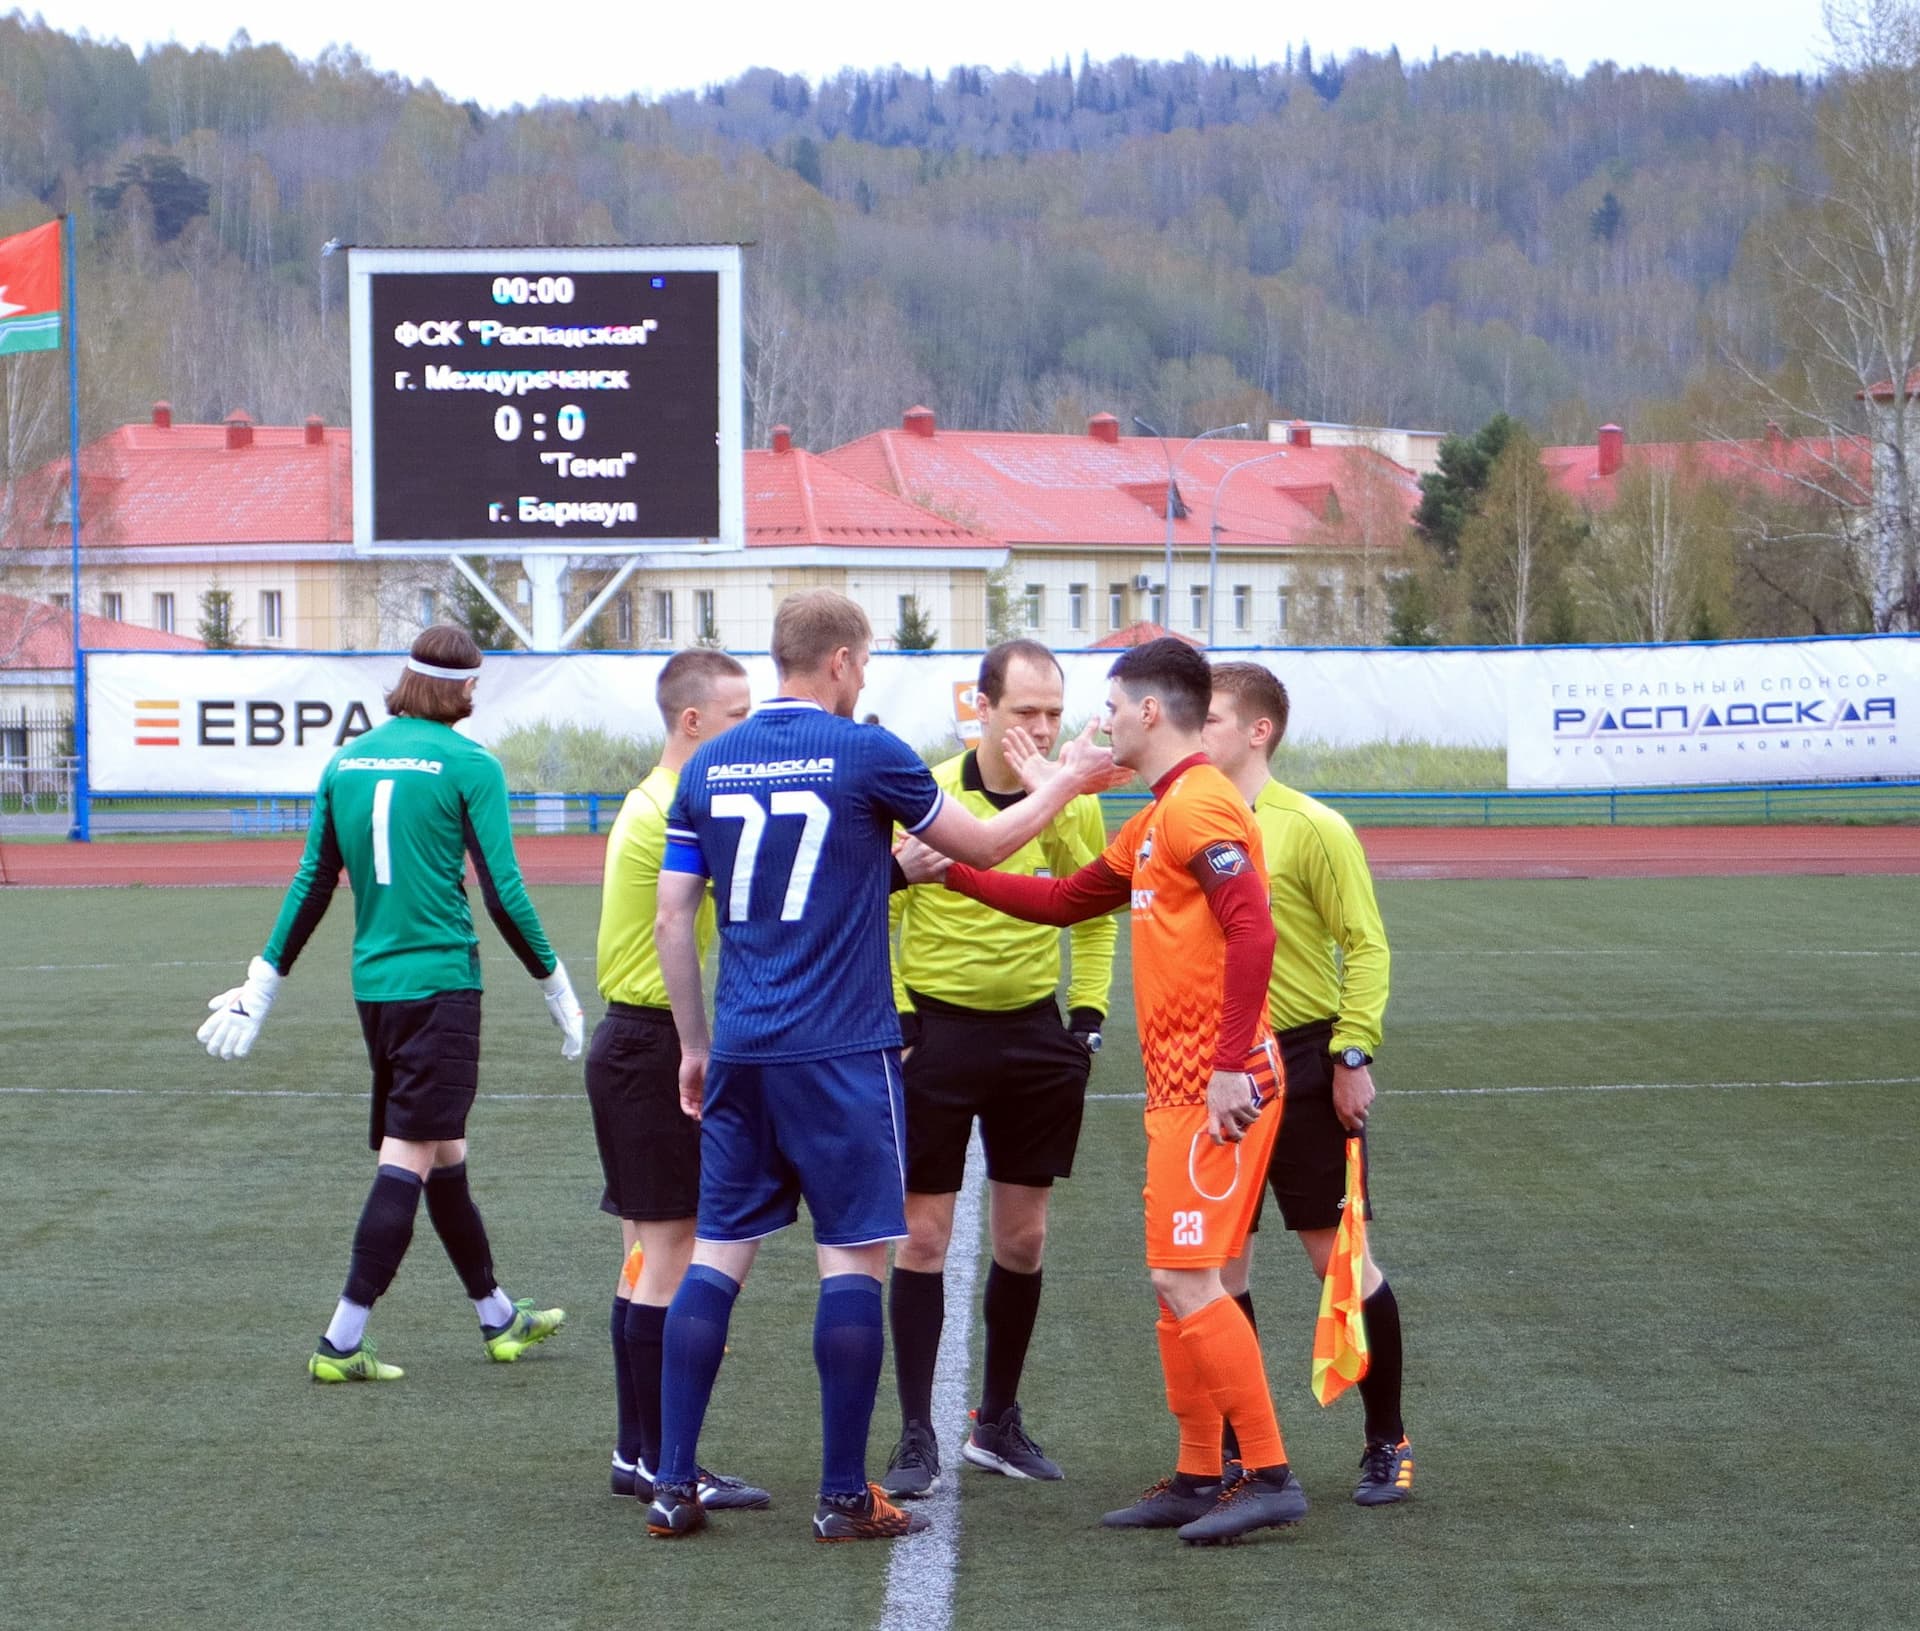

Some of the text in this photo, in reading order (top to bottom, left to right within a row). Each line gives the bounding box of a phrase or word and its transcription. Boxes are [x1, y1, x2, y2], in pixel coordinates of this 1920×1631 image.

[492, 277, 575, 304] 00:00
[394, 321, 464, 348] ФСК
[395, 365, 631, 396] г. Междуреченск
[494, 405, 522, 441] 0
[557, 405, 586, 441] 0
[539, 452, 637, 478] "Темп"
[488, 496, 638, 528] г. Барнаул
[1552, 673, 1889, 698] ГЕНЕРАЛЬНЫЙ СПОНСОР
[1553, 697, 1896, 734] РАСПАДСКАЯ
[1553, 734, 1897, 756] УГОЛЬНАЯ КОМПАНИЯ
[372, 779, 394, 885] 1
[710, 790, 831, 922] 77
[1173, 1211, 1204, 1246] 23
